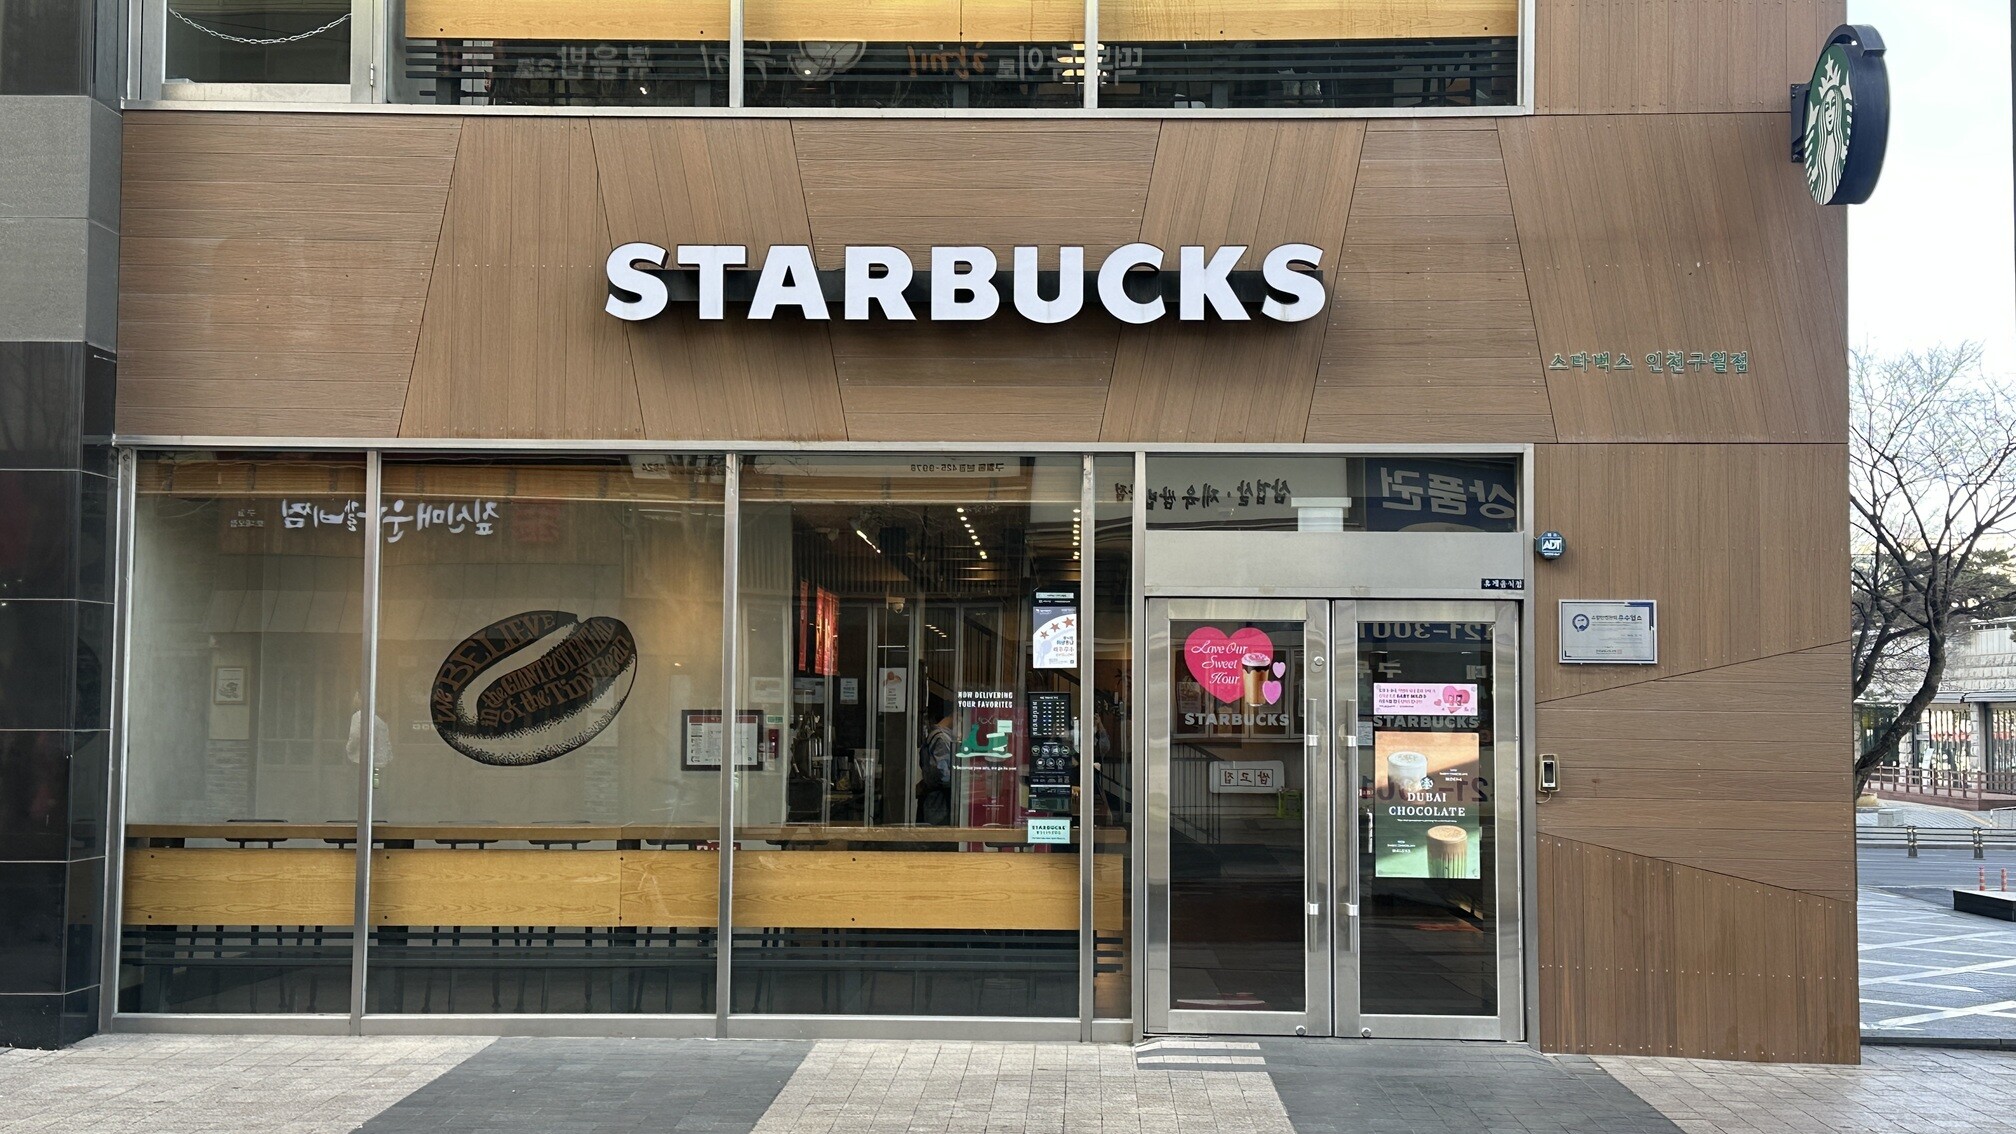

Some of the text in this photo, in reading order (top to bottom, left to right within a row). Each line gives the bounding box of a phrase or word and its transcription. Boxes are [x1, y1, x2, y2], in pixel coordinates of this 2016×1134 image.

[604, 242, 1326, 324] STARBUCKS
[1549, 349, 1749, 374] 스타벅스 인천구월점
[1543, 539, 1562, 550] ADT
[1191, 639, 1248, 654] Love Our
[1202, 655, 1238, 669] Sweet
[436, 614, 556, 725] We BELIEVE
[1209, 671, 1240, 685] Hour
[957, 691, 1013, 699] NOW DELIVERING
[957, 700, 1013, 708] YOUR FAVORITES
[1184, 713, 1290, 726] STARBUCKS
[1373, 715, 1480, 729] STARBUCKS
[1407, 792, 1447, 802] DUBAI
[1388, 805, 1466, 817] CHOCOLATE
